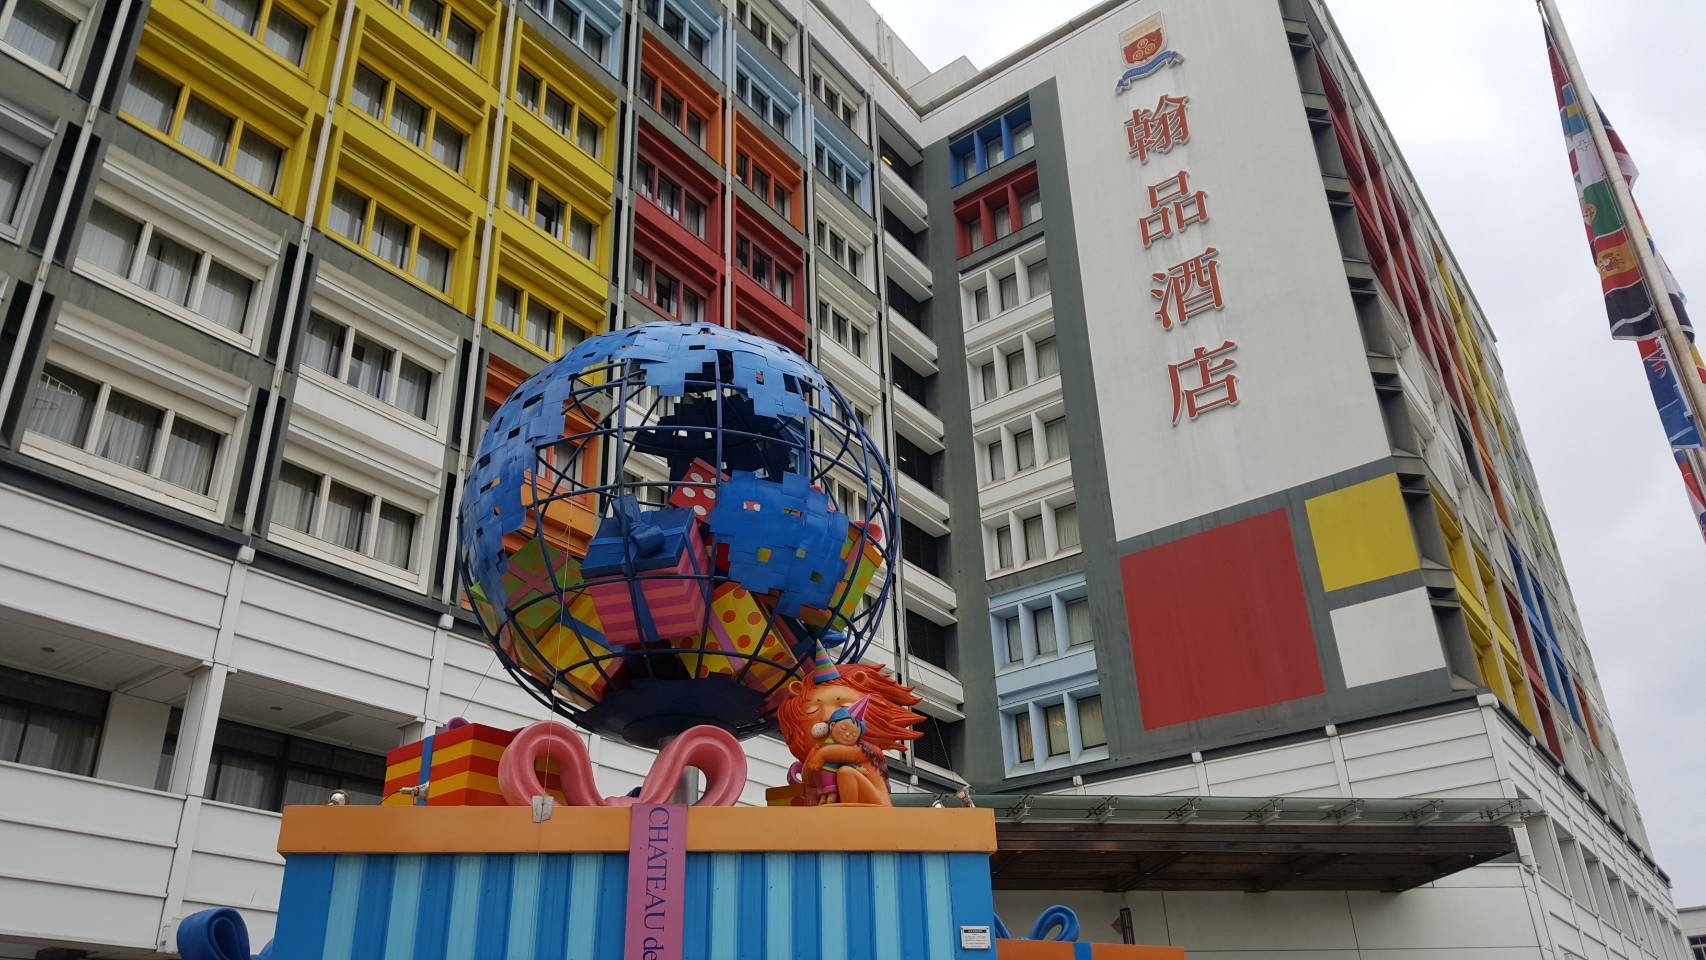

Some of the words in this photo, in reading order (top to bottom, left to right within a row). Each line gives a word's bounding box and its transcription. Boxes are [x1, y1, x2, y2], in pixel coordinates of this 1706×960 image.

[1124, 94, 1240, 427] 翰品酒店
[643, 806, 670, 932] CHATEAU
[642, 936, 665, 960] de
